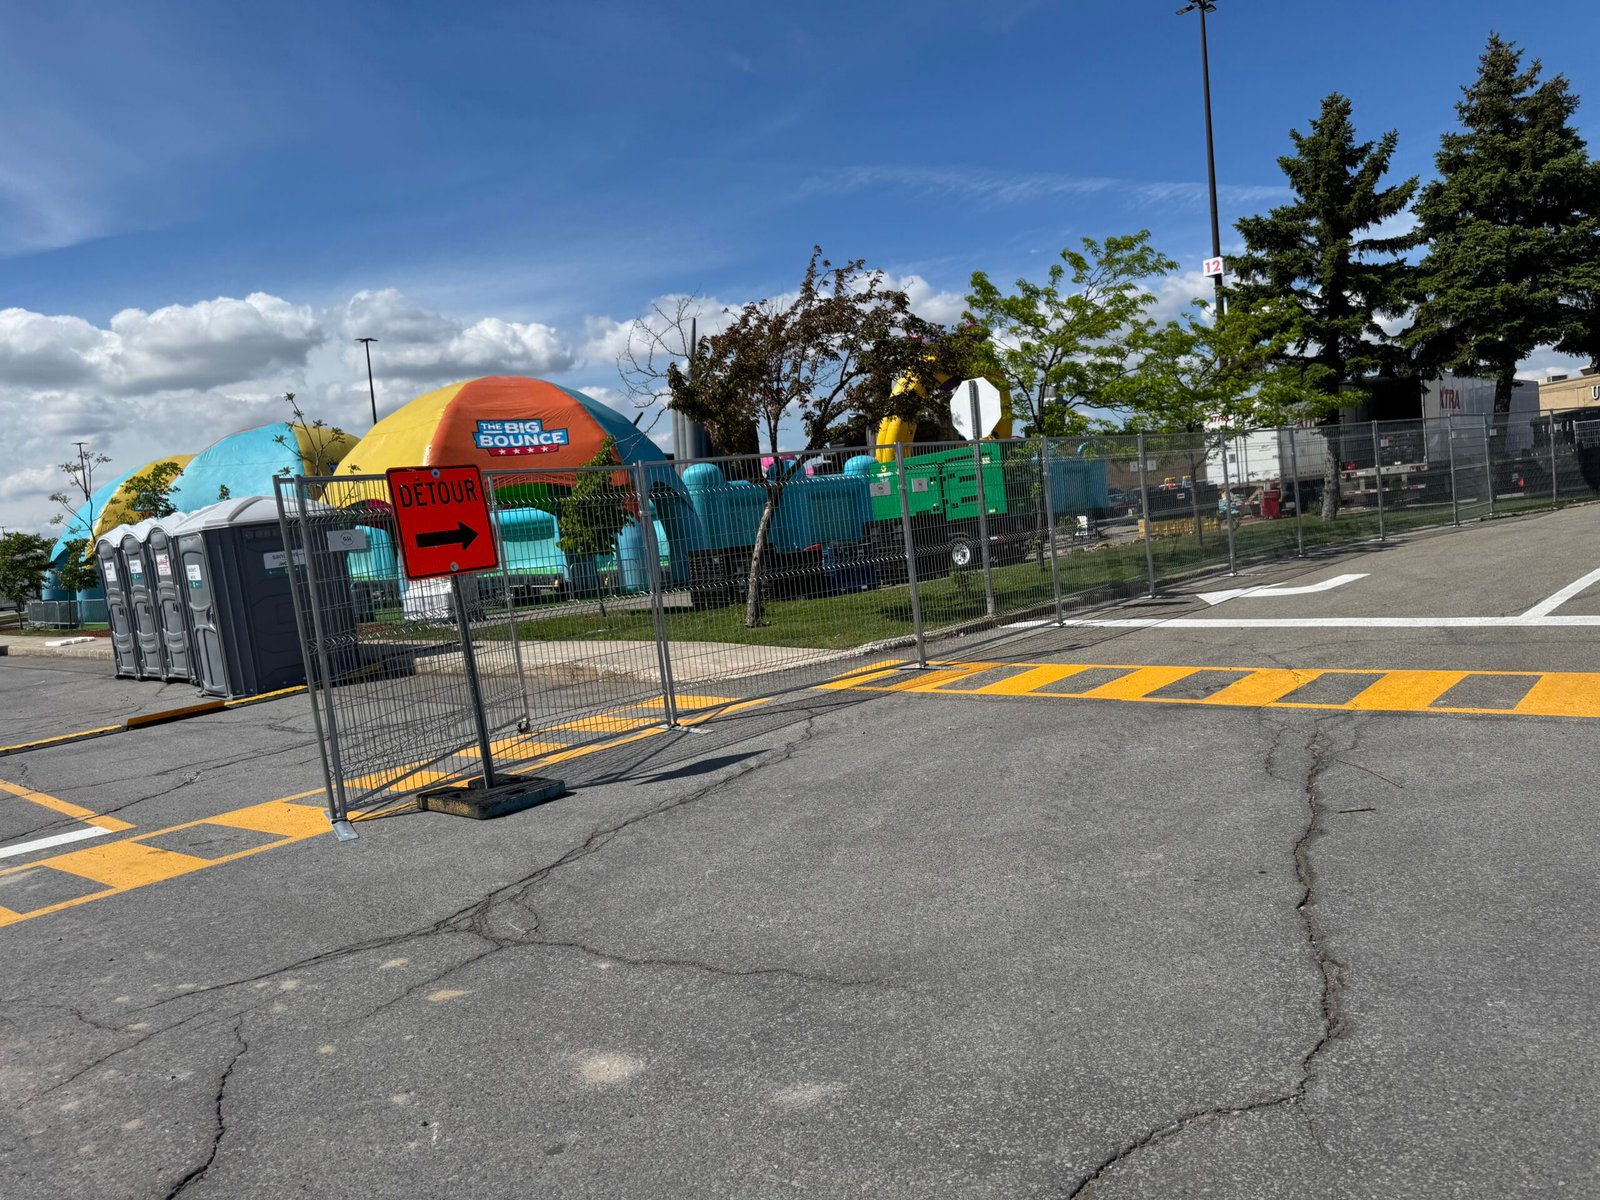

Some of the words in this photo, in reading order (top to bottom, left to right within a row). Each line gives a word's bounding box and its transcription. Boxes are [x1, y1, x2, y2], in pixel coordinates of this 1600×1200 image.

[1205, 260, 1221, 273] 12
[1440, 386, 1461, 410] XTRA
[480, 423, 502, 431] THE
[504, 421, 540, 434] BIG
[479, 431, 565, 447] BOUNCE
[398, 477, 479, 508] DÉTOUR
